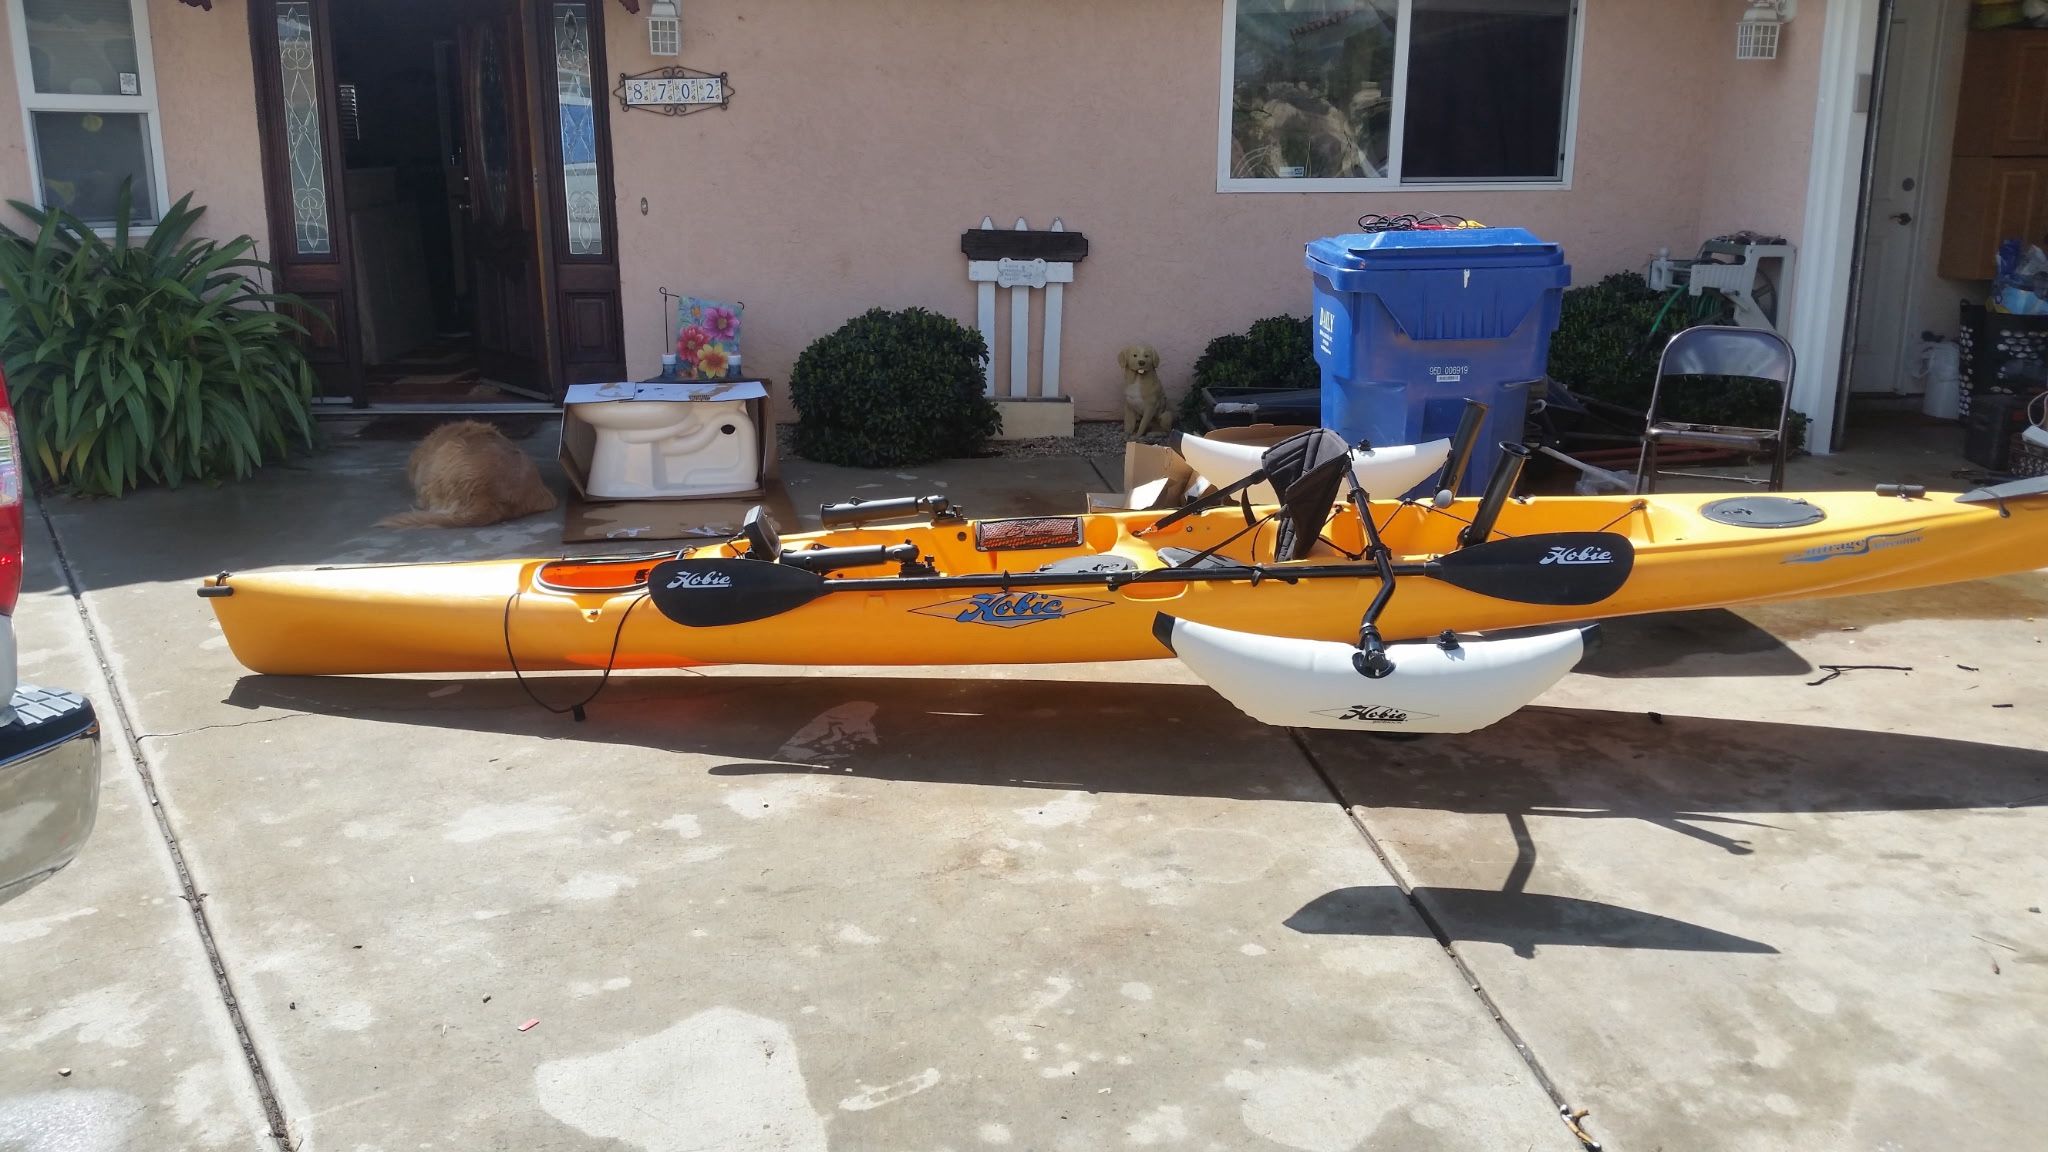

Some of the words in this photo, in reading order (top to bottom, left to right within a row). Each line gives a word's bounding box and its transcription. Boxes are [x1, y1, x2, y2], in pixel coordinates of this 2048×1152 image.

[633, 83, 714, 100] 8702
[1539, 546, 1612, 565] Hobie
[666, 571, 731, 589] Hobie
[955, 591, 1064, 622] Hobie
[1339, 704, 1408, 722] Hobie
